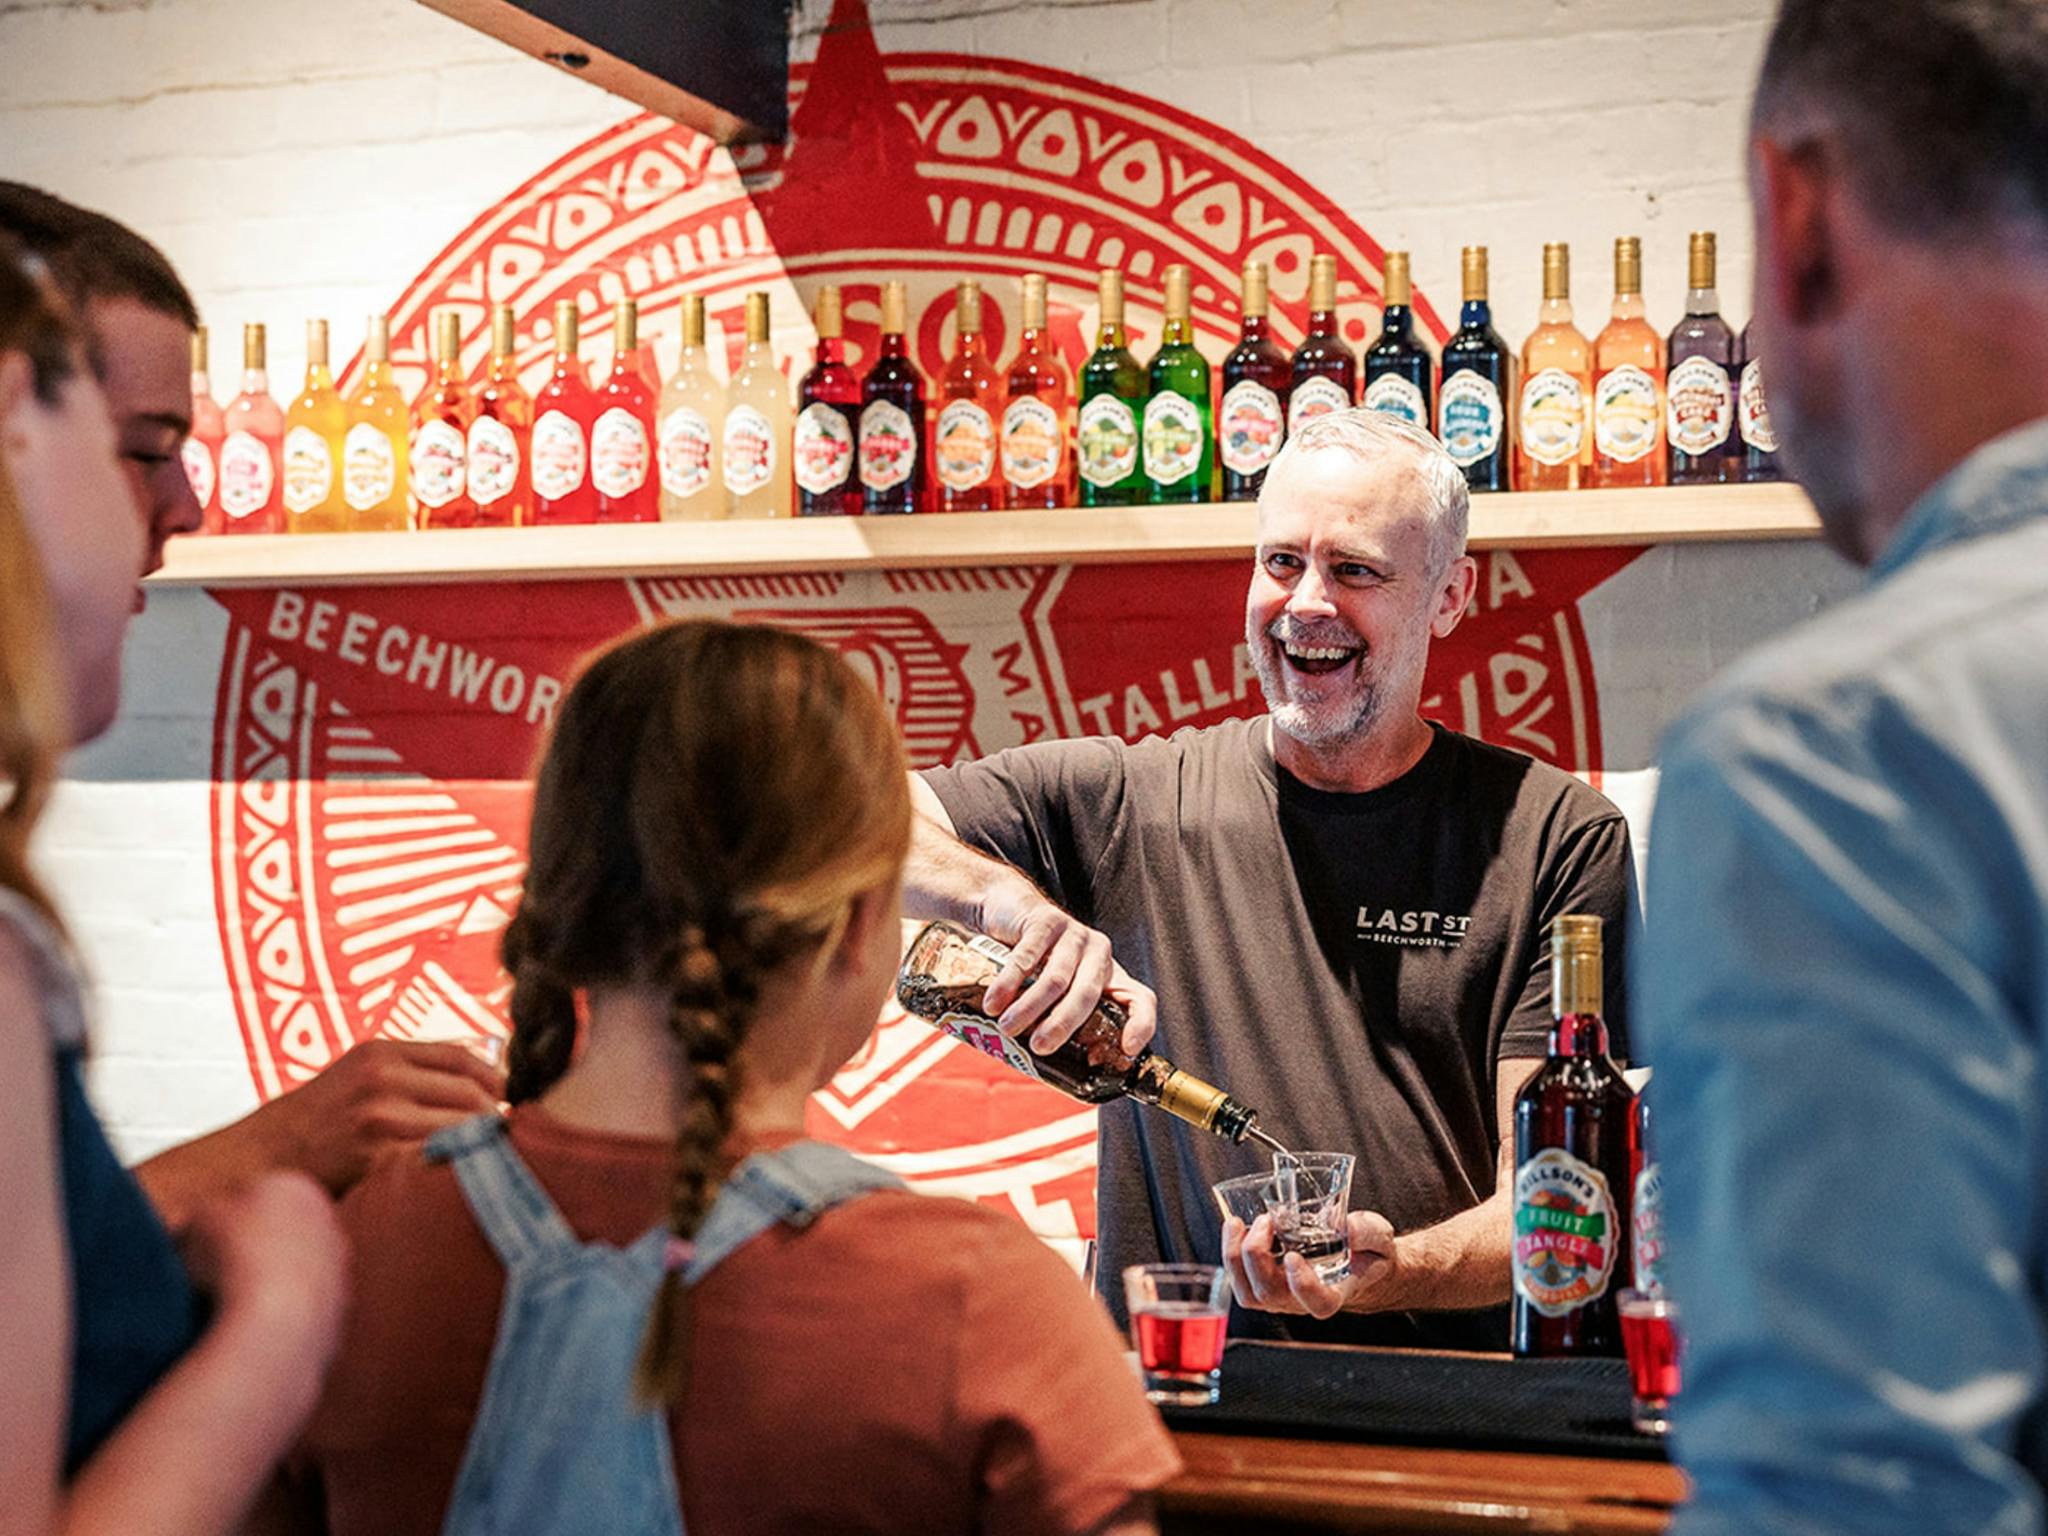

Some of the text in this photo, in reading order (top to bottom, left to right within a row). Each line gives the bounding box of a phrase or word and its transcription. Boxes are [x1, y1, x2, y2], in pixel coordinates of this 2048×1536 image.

[1356, 905, 1472, 933] LAST ST
[1373, 933, 1447, 948] BEECHWORTH
[1521, 1166, 1595, 1199] BILLSON'S
[1528, 1209, 1584, 1233] FRUIT
